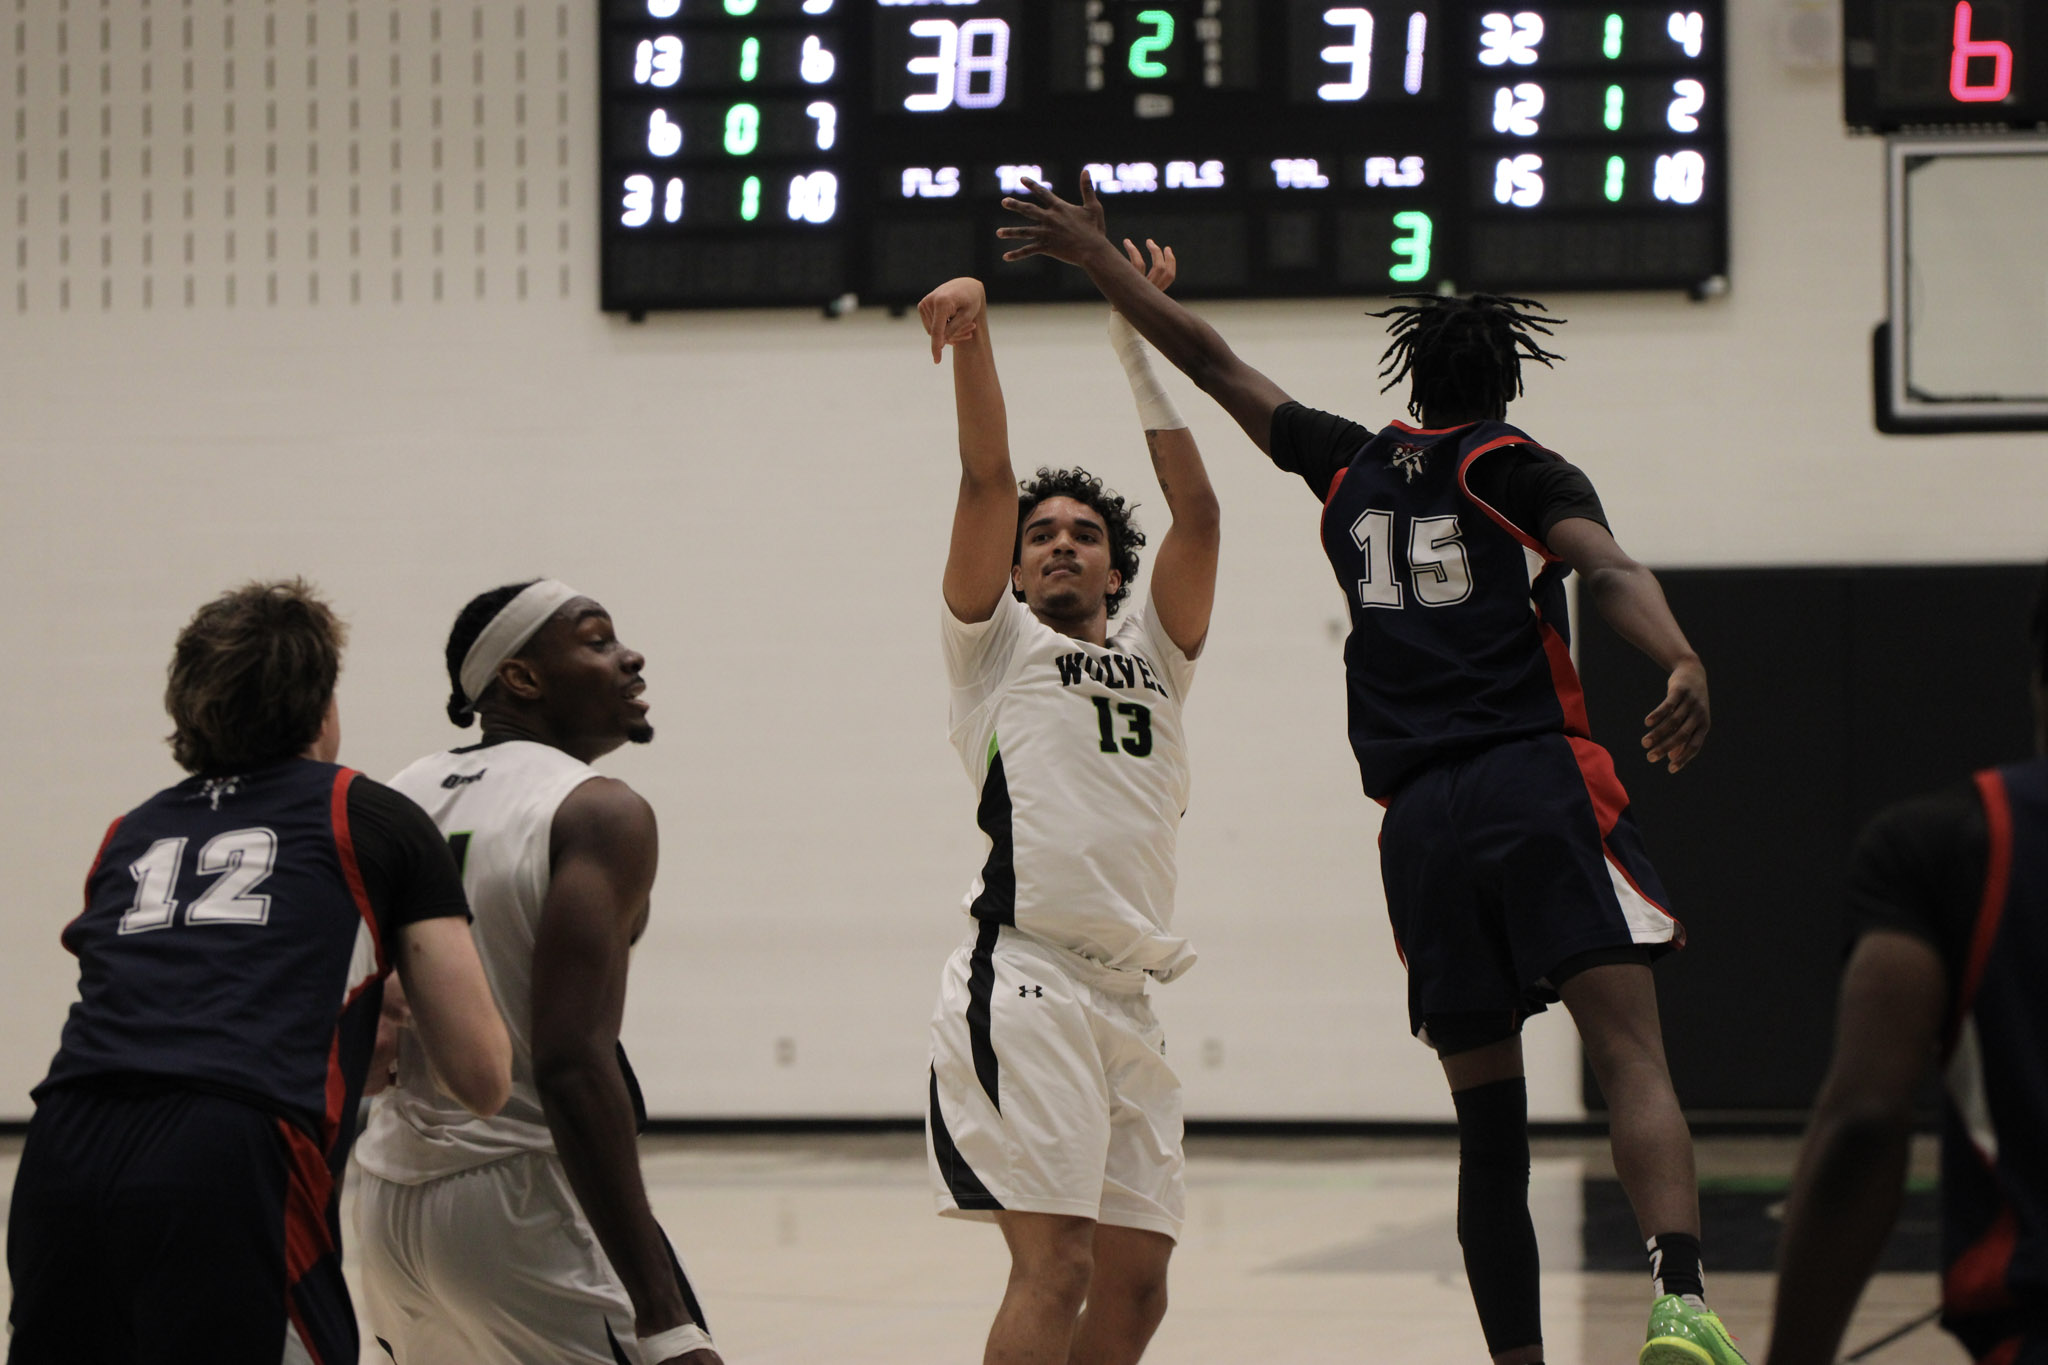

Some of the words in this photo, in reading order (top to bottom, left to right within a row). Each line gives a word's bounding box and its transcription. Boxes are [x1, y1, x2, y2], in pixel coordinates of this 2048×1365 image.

[634, 35, 684, 88] 13
[740, 37, 760, 82] 1
[800, 35, 836, 84] 6
[904, 19, 1010, 112] 38
[1128, 10, 1175, 78] 2
[1317, 8, 1427, 101] 31
[1478, 12, 1544, 66] 32
[1603, 14, 1623, 59] 1
[1667, 12, 1704, 57] 4
[1949, 1, 2013, 102] 6
[647, 108, 683, 157] 6
[724, 103, 760, 155] 0
[806, 101, 837, 150] 7
[1492, 83, 1545, 136] 12
[1604, 85, 1624, 131] 1
[1666, 79, 1705, 133] 2
[621, 174, 684, 228] 31
[741, 176, 761, 221] 1
[787, 171, 838, 224] 10
[1494, 154, 1544, 208] 15
[1605, 156, 1625, 201] 1
[1653, 150, 1705, 204] 10
[1389, 211, 1433, 281] 3
[1349, 508, 1474, 610] 15
[1091, 695, 1153, 758] 13
[117, 826, 278, 935] 12
